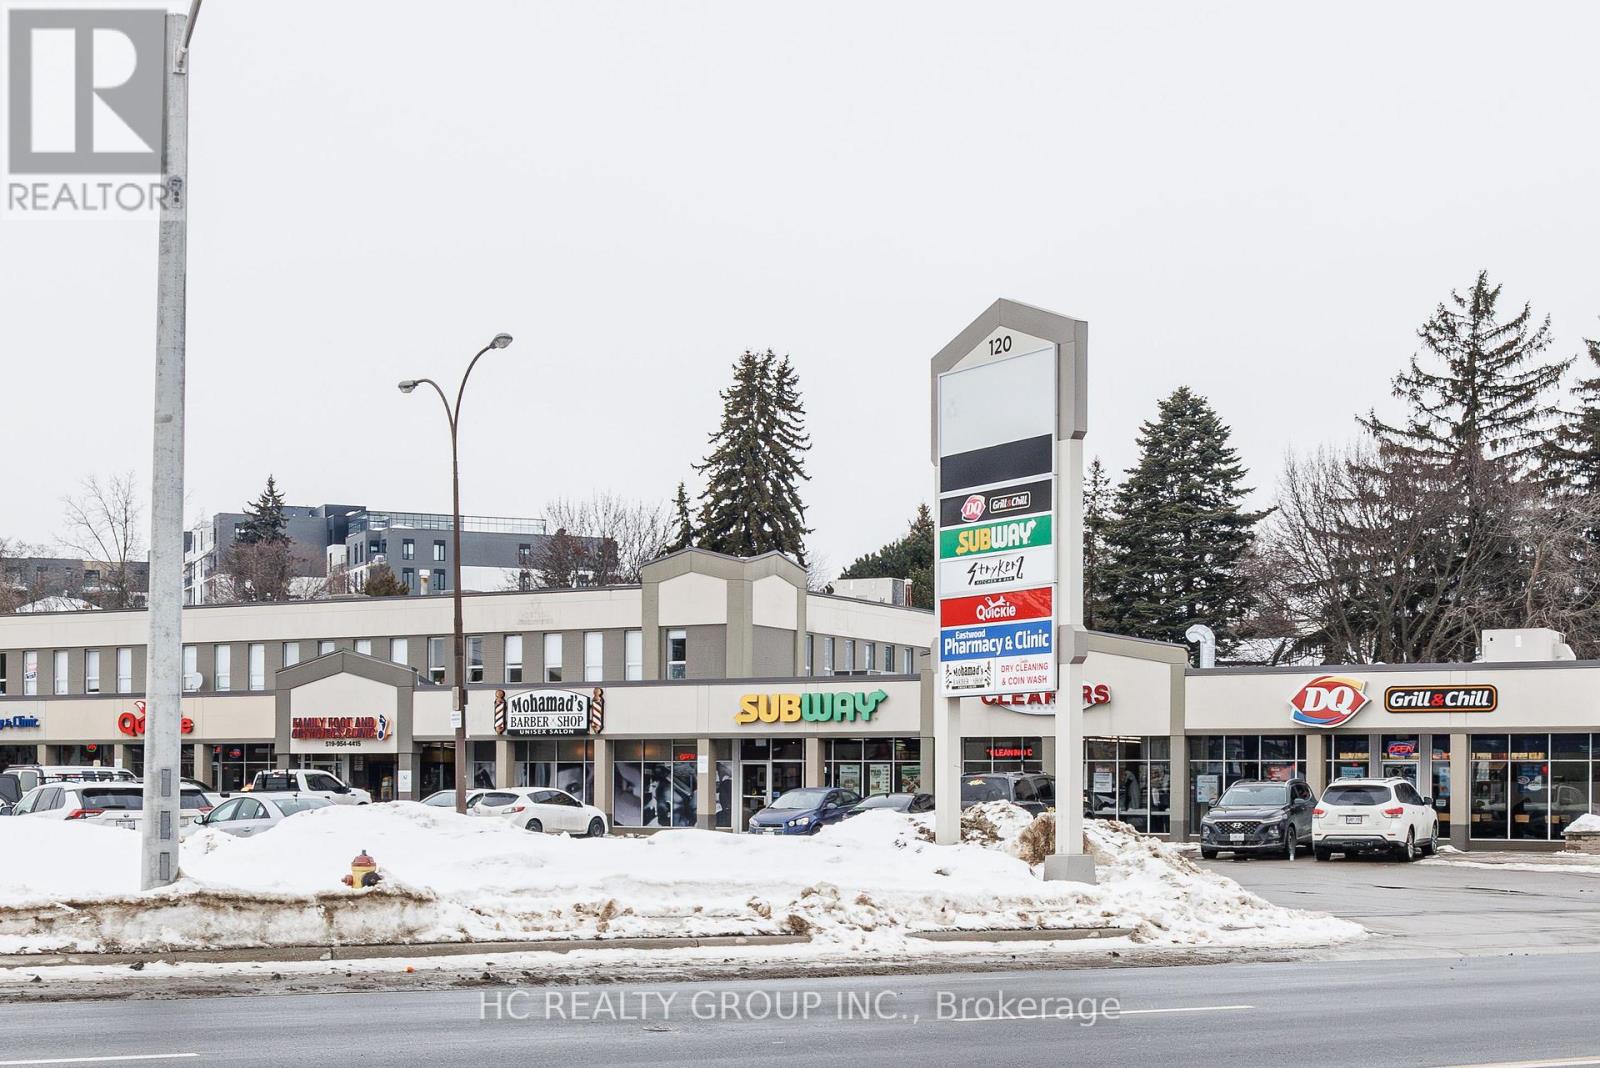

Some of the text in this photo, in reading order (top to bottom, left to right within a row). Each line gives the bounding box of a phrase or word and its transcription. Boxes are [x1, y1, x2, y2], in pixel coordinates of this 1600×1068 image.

[989, 336, 1012, 355] 120
[966, 503, 982, 515] DQ
[956, 519, 1036, 555] SUBWAY
[976, 602, 1016, 621] Quickie
[945, 630, 1050, 656] Pharmacy & Clinic
[956, 629, 985, 640] Eastwood
[1001, 662, 1049, 673] DRY CLEANING
[1008, 676, 1025, 685] COIN
[1026, 675, 1048, 685] WASH
[511, 694, 584, 713] Mohamad's
[735, 689, 888, 725] SUBWAY
[1302, 686, 1356, 714] DQ
[510, 716, 584, 728] BARBER SHOP
